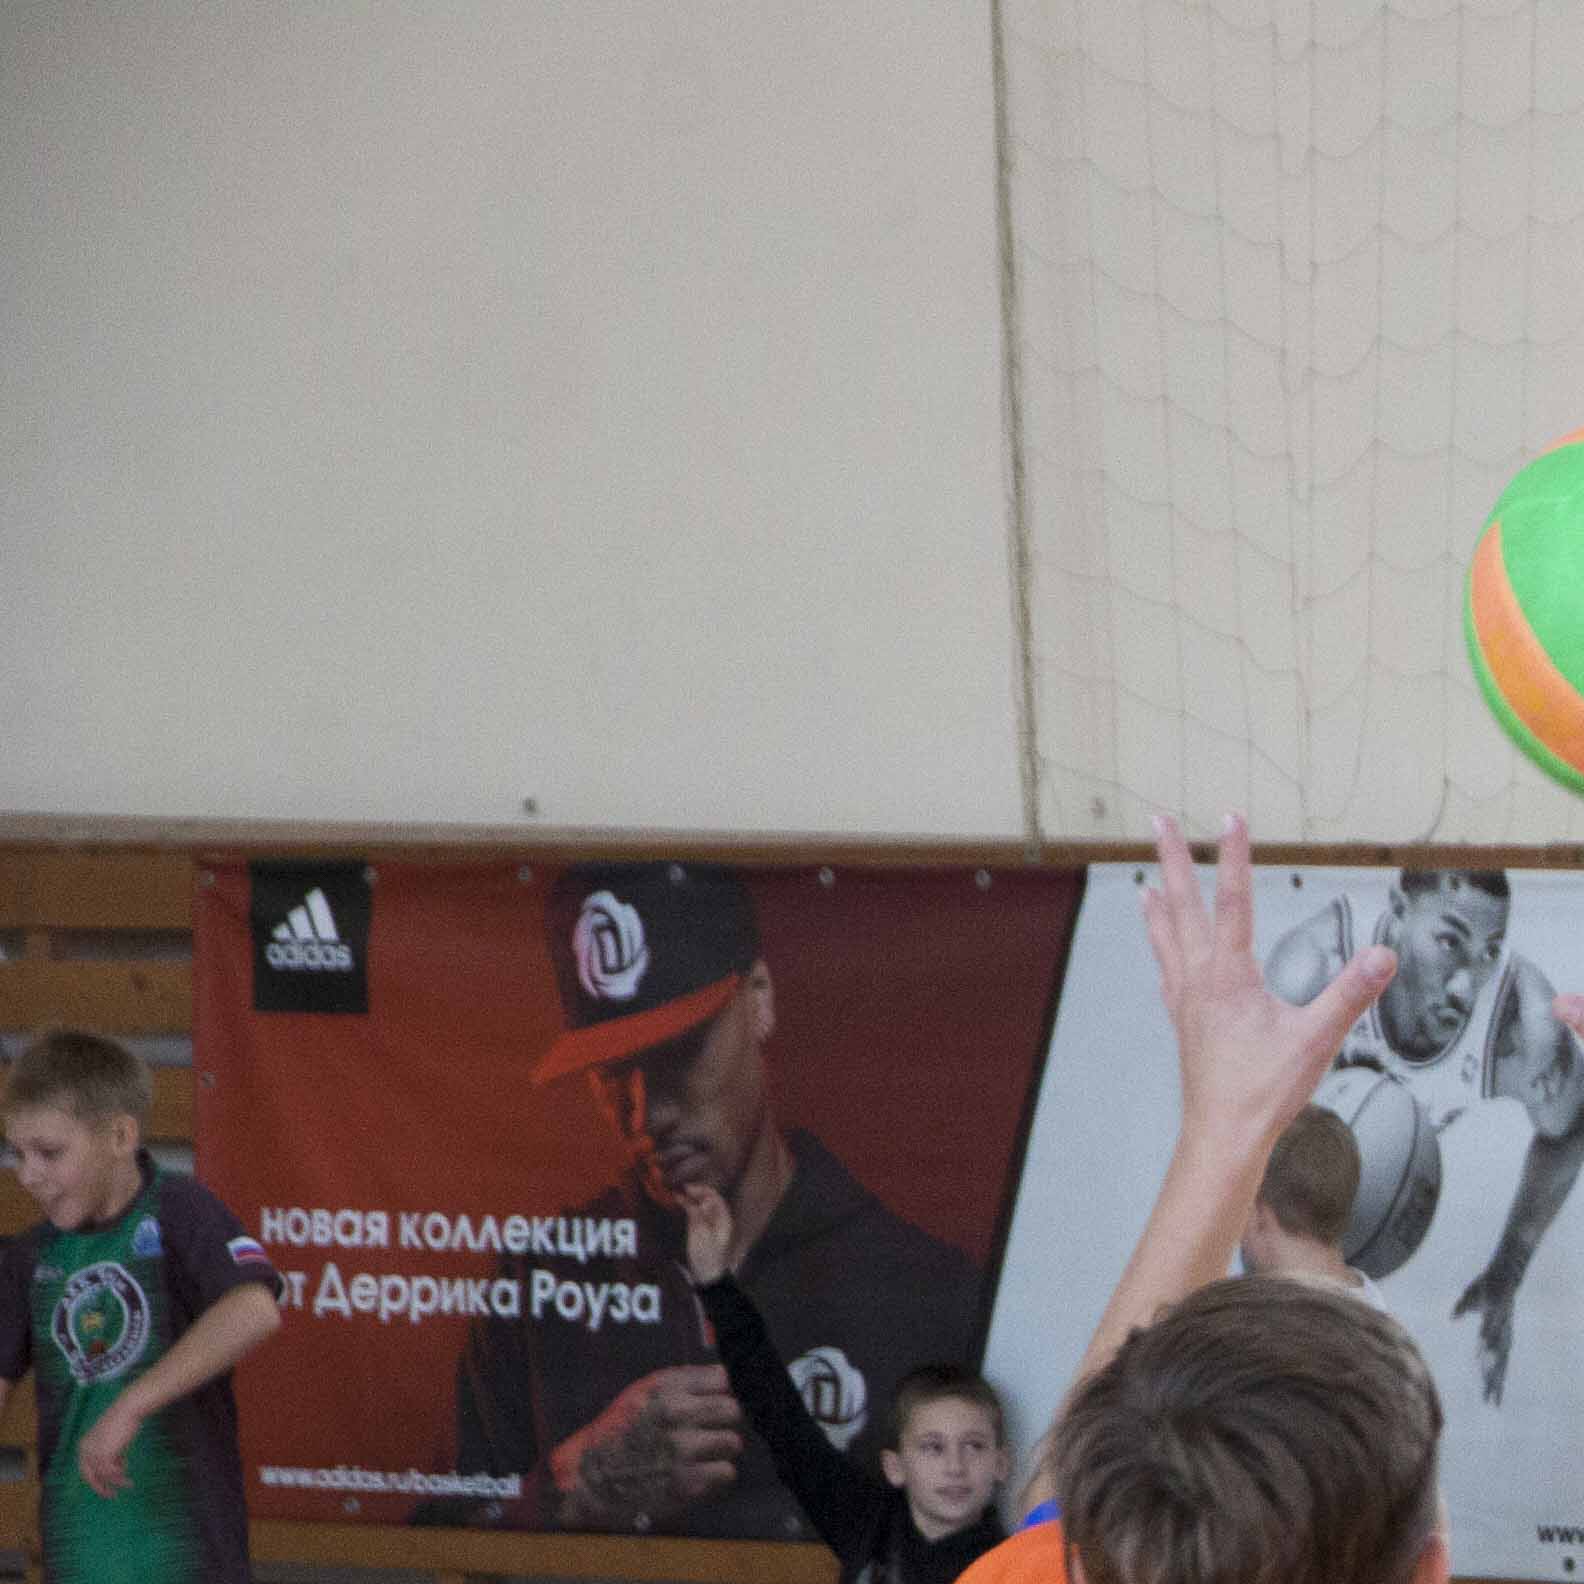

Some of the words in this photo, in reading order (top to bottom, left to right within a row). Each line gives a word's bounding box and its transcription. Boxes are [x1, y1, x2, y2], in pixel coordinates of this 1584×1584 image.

[265, 938, 353, 971] adidas
[399, 1211, 639, 1263] коллекция
[313, 1261, 519, 1325] Деррика
[530, 1267, 661, 1331] Роуза
